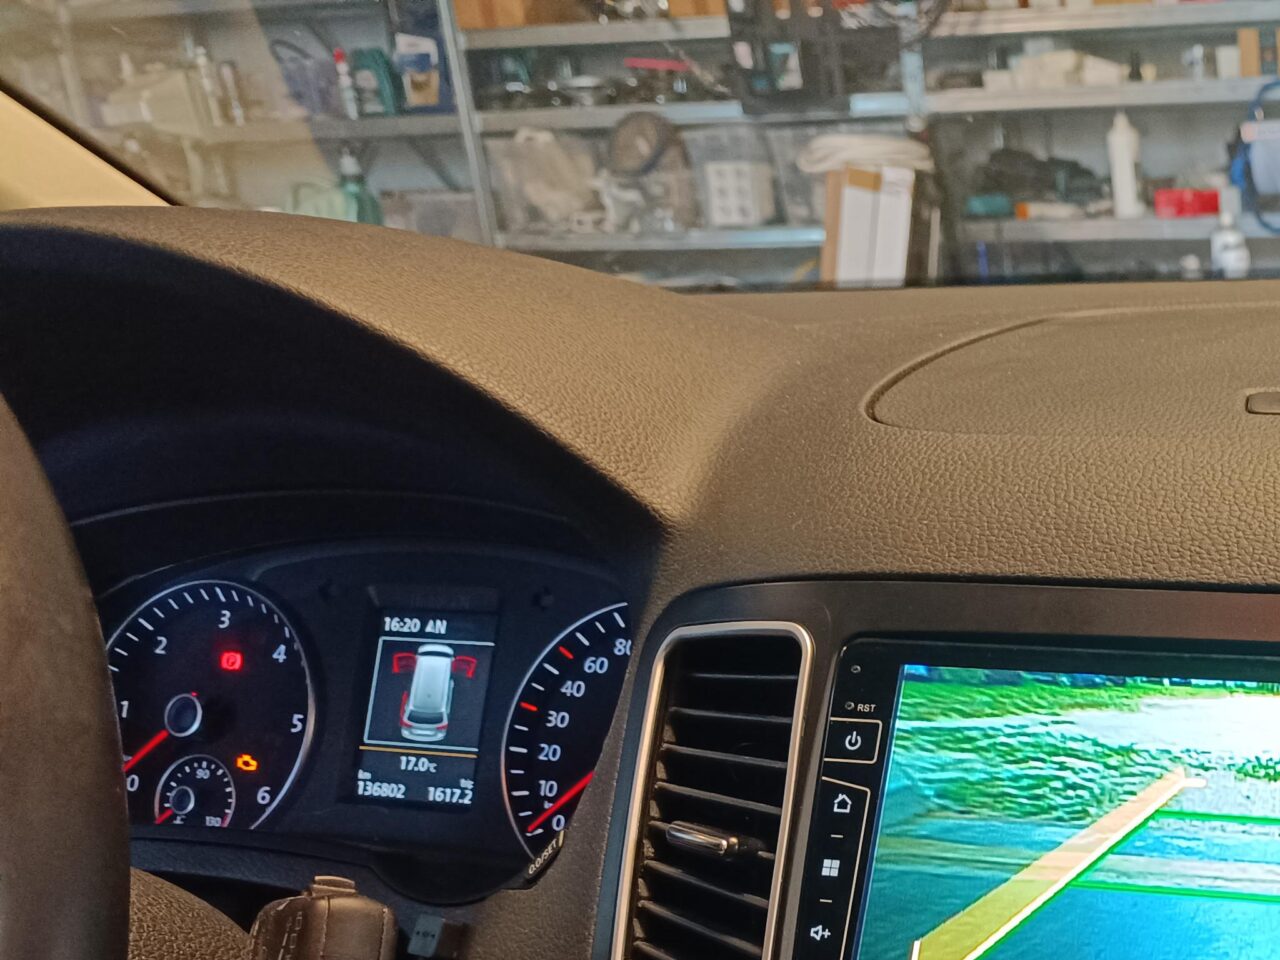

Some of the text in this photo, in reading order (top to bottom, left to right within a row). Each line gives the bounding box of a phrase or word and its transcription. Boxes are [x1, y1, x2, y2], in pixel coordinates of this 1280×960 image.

[218, 610, 231, 628] 3
[384, 616, 421, 633] 16:20
[154, 636, 168, 654] 2
[272, 644, 287, 663] 4
[584, 656, 609, 674] 60
[560, 680, 586, 698] 40
[120, 700, 129, 718] 1
[857, 703, 877, 713] RST
[290, 714, 304, 733] 5
[545, 710, 570, 728] 30
[537, 743, 562, 762] 20
[126, 774, 139, 792] 0
[357, 780, 406, 799] 136802
[538, 780, 559, 798] 10
[257, 786, 272, 805] 6
[427, 786, 474, 804] 1617.2
[551, 814, 566, 832] 0
[528, 838, 559, 875] 0.0/SET
